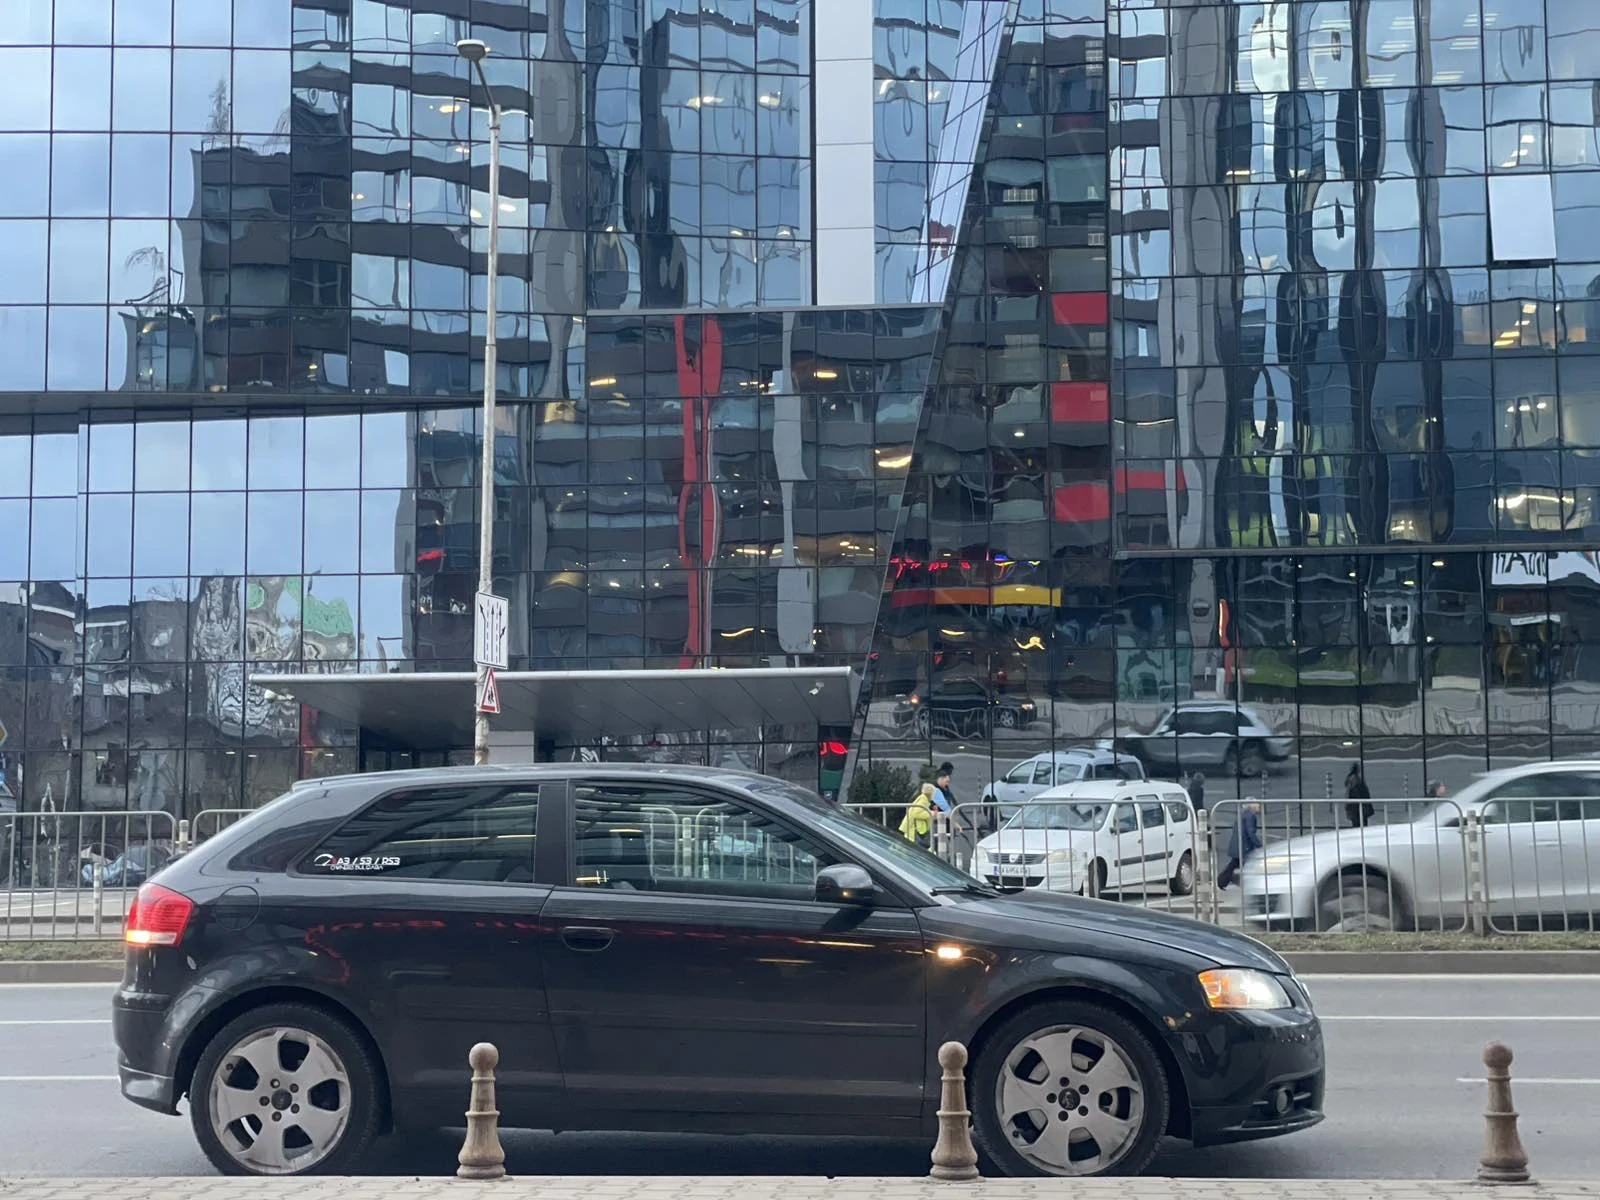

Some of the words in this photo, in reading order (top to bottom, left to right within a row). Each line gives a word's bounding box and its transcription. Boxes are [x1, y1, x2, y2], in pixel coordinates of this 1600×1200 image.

[337, 857, 350, 865] A3
[360, 857, 372, 865] S3
[381, 857, 400, 866] RS3
